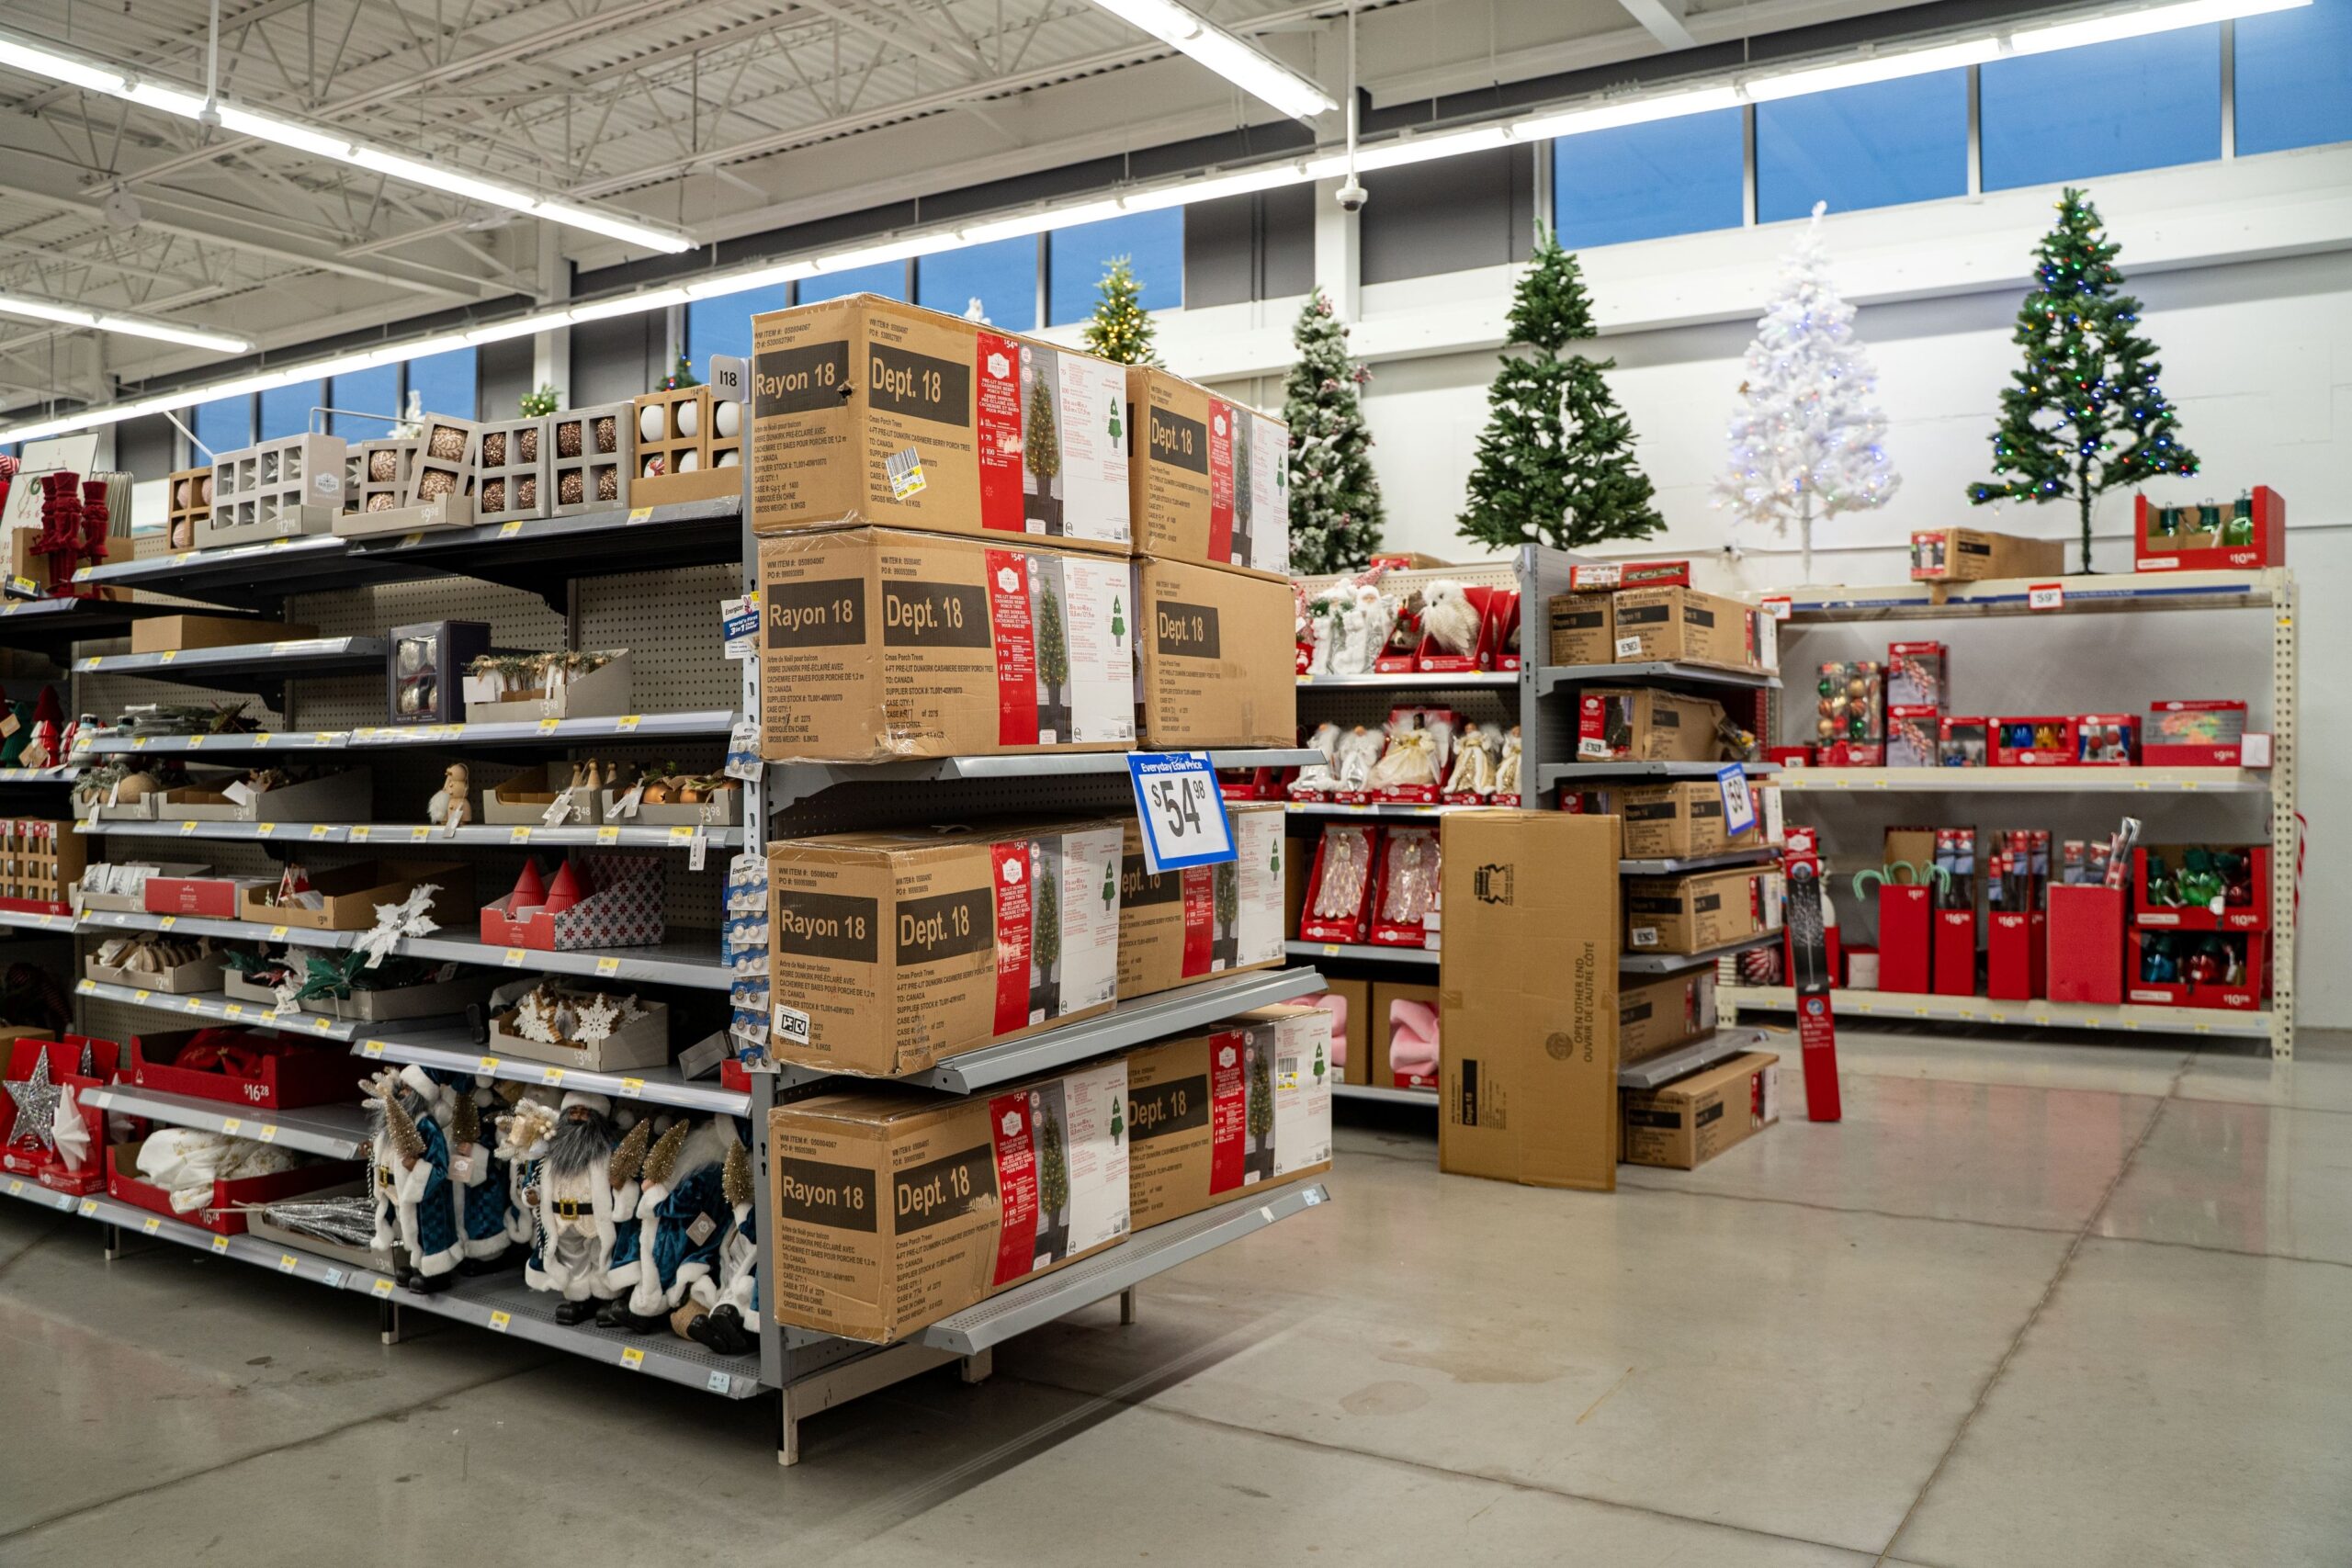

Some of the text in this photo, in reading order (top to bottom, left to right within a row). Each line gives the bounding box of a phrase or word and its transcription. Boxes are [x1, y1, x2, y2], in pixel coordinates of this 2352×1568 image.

[756, 362, 835, 399] Rayon 18
[873, 356, 941, 403] Dept. 18
[1151, 417, 1193, 456] Dept. 18
[725, 604, 744, 615] Energizer
[770, 599, 853, 632] Rayon 18
[887, 594, 963, 636] Dept. 18
[729, 627, 735, 636] 3
[1159, 612, 1204, 646] Dept. 18
[886, 687, 908, 695] SUPPLIER
[1141, 762, 1174, 773] Everyday
[1185, 761, 1203, 770] Price
[731, 865, 753, 874] Energizer
[1121, 865, 1145, 898] ept.
[781, 909, 865, 941] Rayon 18
[900, 905, 970, 950] Dept. 18
[779, 979, 804, 989] CACHEMIRE
[810, 983, 823, 992] BAIES
[824, 985, 837, 993] POUR
[838, 987, 856, 996] PORCHE
[795, 971, 814, 980] DUNKIRK
[1585, 970, 1594, 1007] L'AUTRE
[787, 990, 805, 999] CANADA
[801, 1001, 814, 1010] STOCK
[1574, 957, 1584, 1043] OPEN OTHER END
[1584, 1009, 1593, 1023] DE
[1584, 1025, 1593, 1063] OUVRIR
[1128, 1089, 1187, 1130] Dept. 18
[790, 1135, 803, 1145] ITEM
[783, 1176, 864, 1210] Rayon 18
[899, 1165, 970, 1216] Dept. 18
